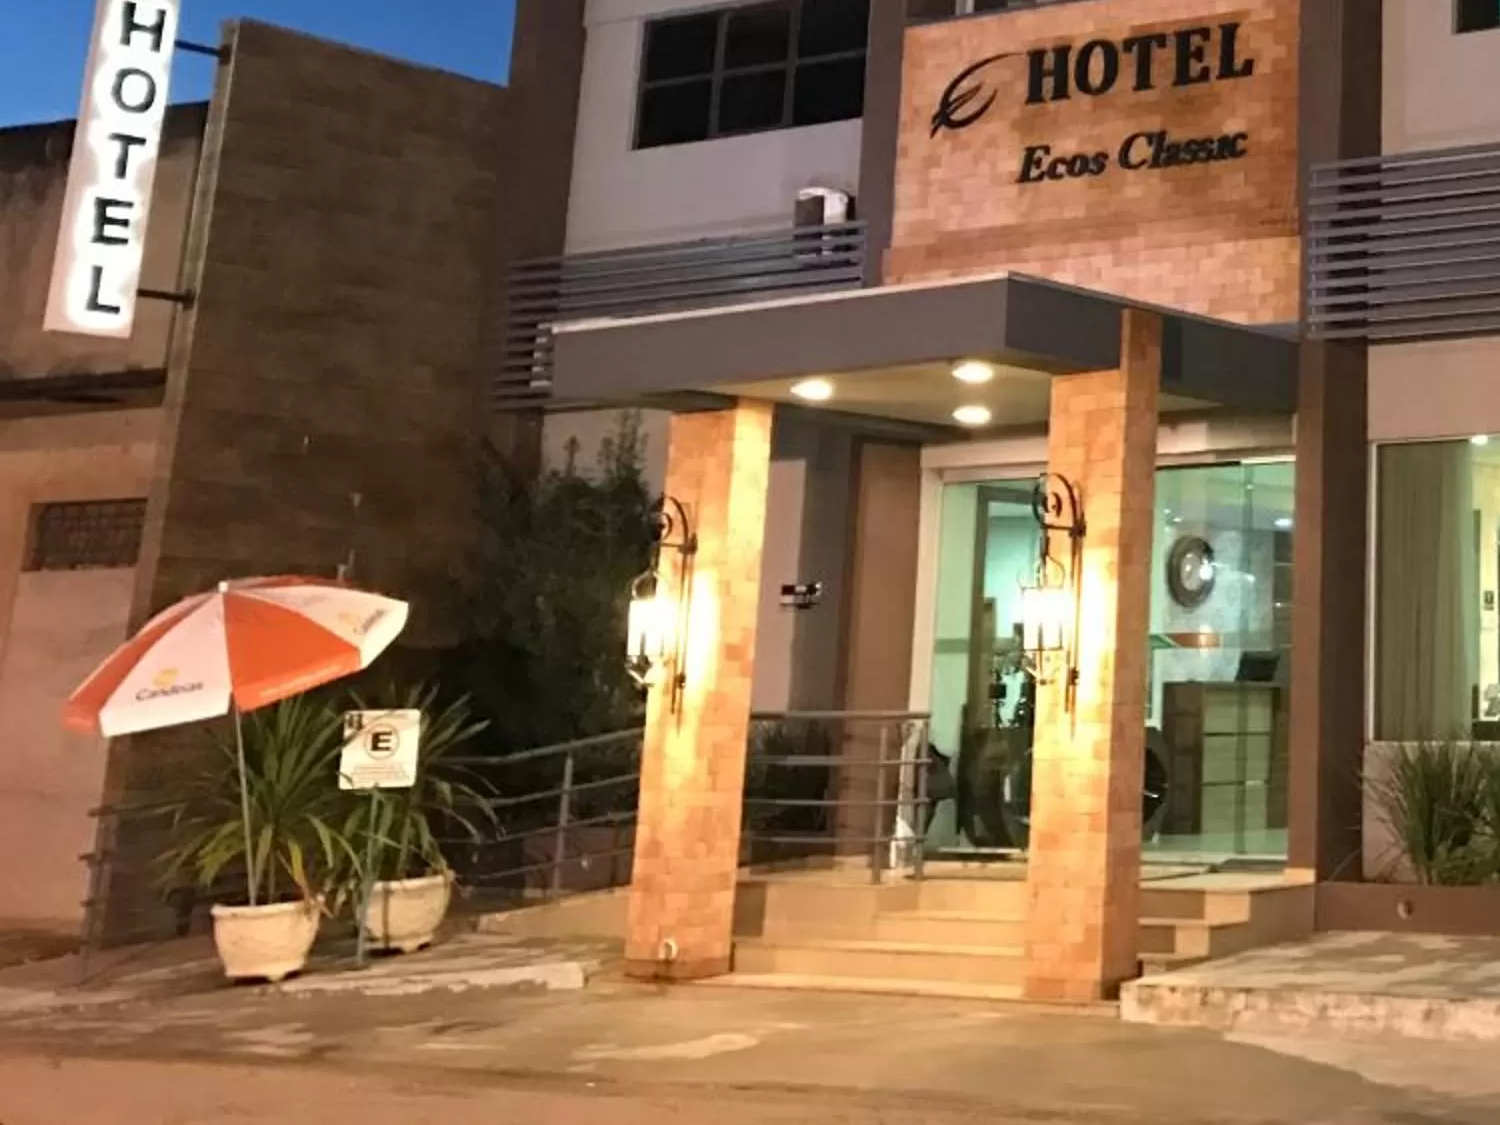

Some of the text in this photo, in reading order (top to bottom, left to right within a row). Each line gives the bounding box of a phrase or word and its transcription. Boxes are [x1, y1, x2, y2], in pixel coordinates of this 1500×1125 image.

[1024, 22, 1255, 104] HOTEL
[85, 1, 166, 314] HOTEL
[1014, 129, 1248, 183] Ecos Classic
[371, 730, 393, 751] E
